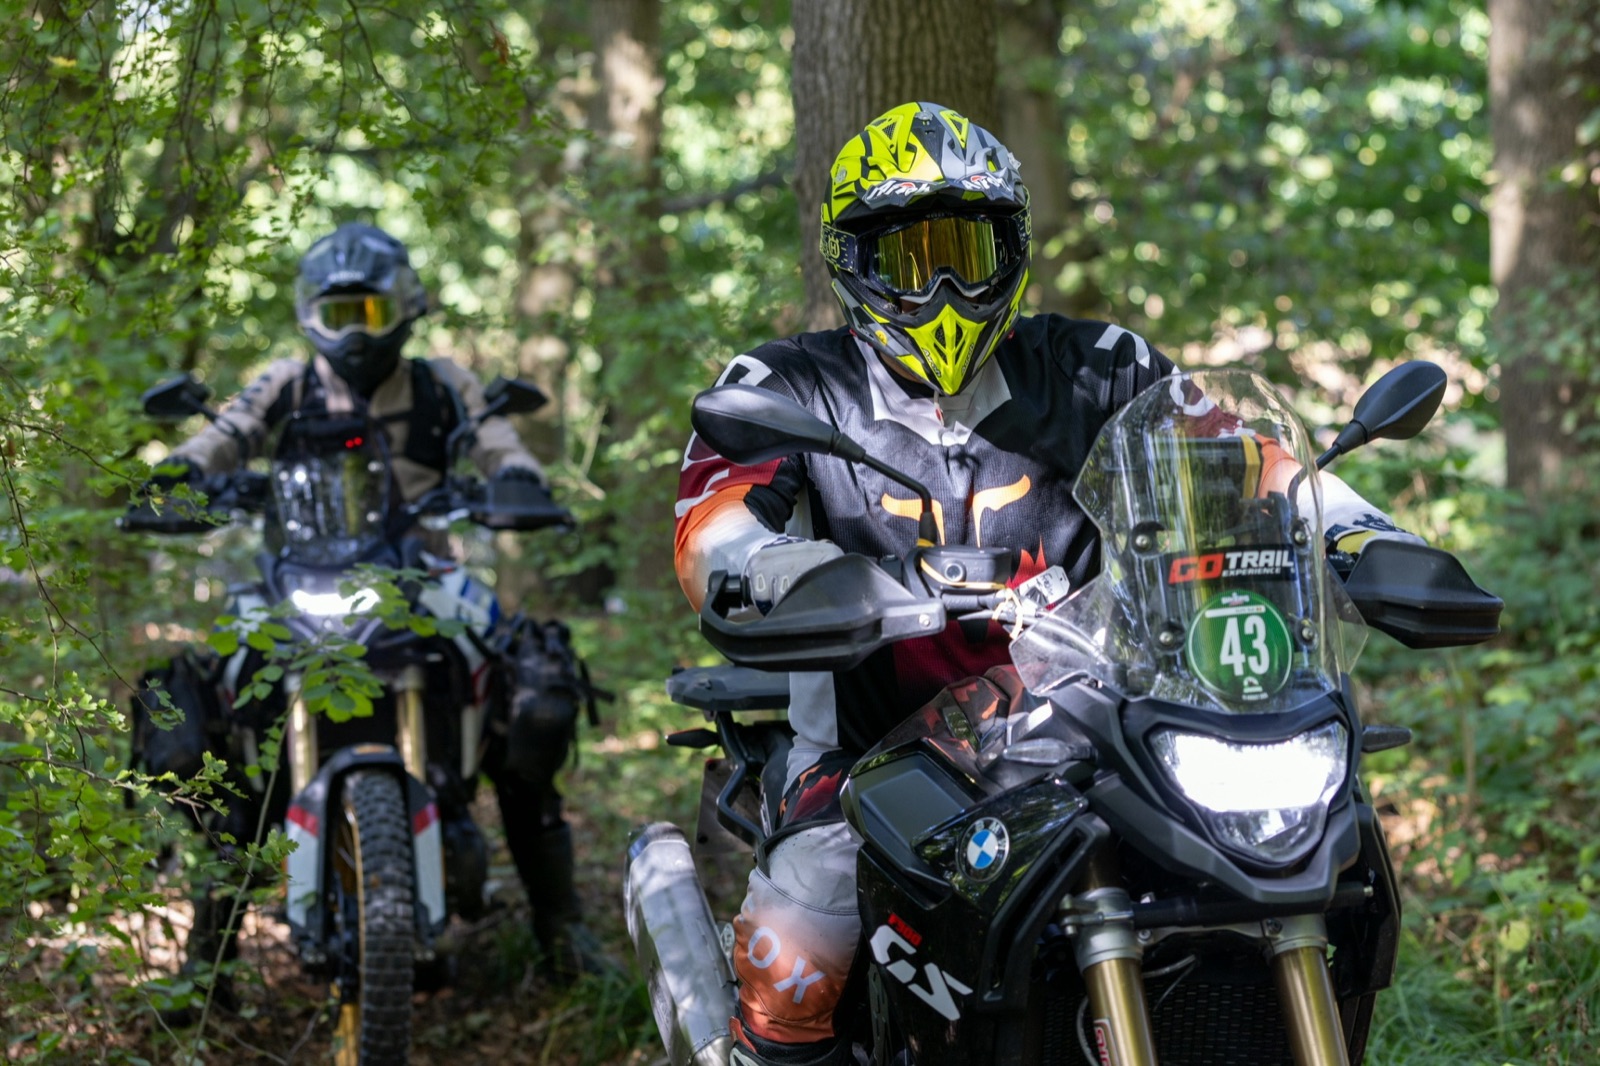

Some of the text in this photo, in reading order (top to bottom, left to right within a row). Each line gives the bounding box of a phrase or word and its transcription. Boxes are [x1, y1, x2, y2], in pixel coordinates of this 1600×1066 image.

[1169, 550, 1294, 584] GO TRAIL
[1222, 568, 1281, 577] EXPERIENCE
[1219, 614, 1270, 677] 43
[869, 923, 974, 1022] GS
